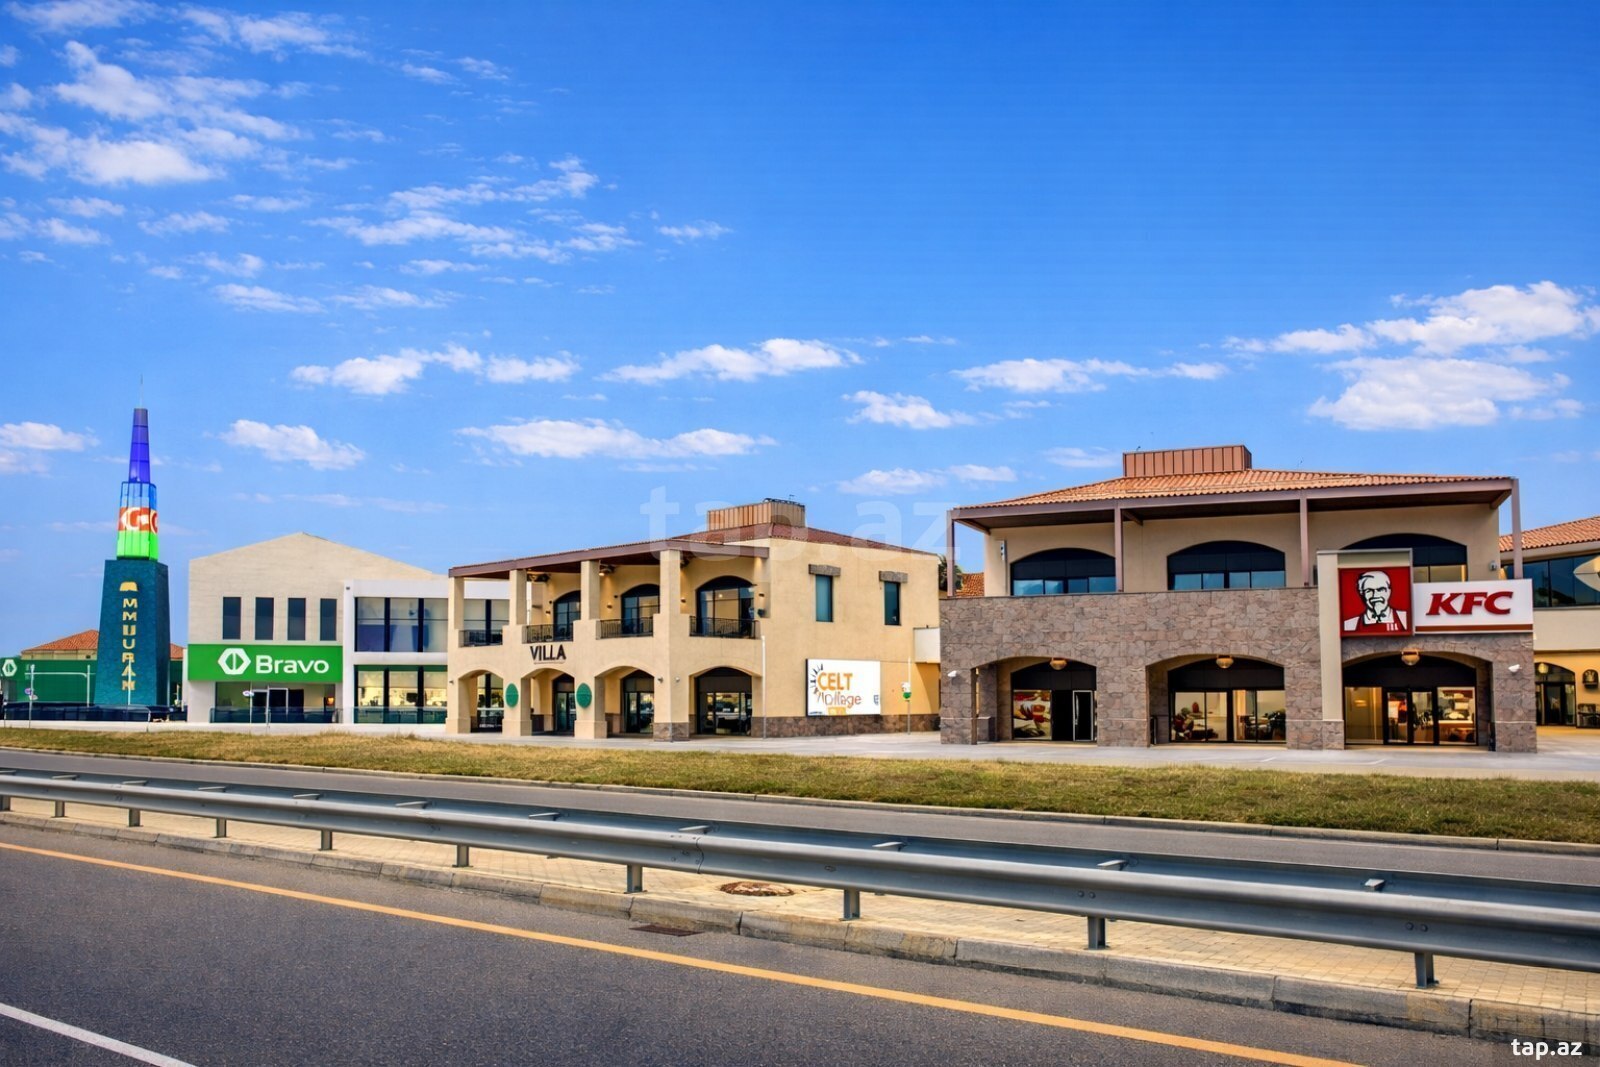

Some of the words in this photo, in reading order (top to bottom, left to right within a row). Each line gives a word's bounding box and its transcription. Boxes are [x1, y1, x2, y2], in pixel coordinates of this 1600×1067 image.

[1425, 591, 1514, 616] KFC
[529, 643, 567, 661] VILLA
[255, 654, 330, 674] Bravo
[816, 671, 853, 691] CELT
